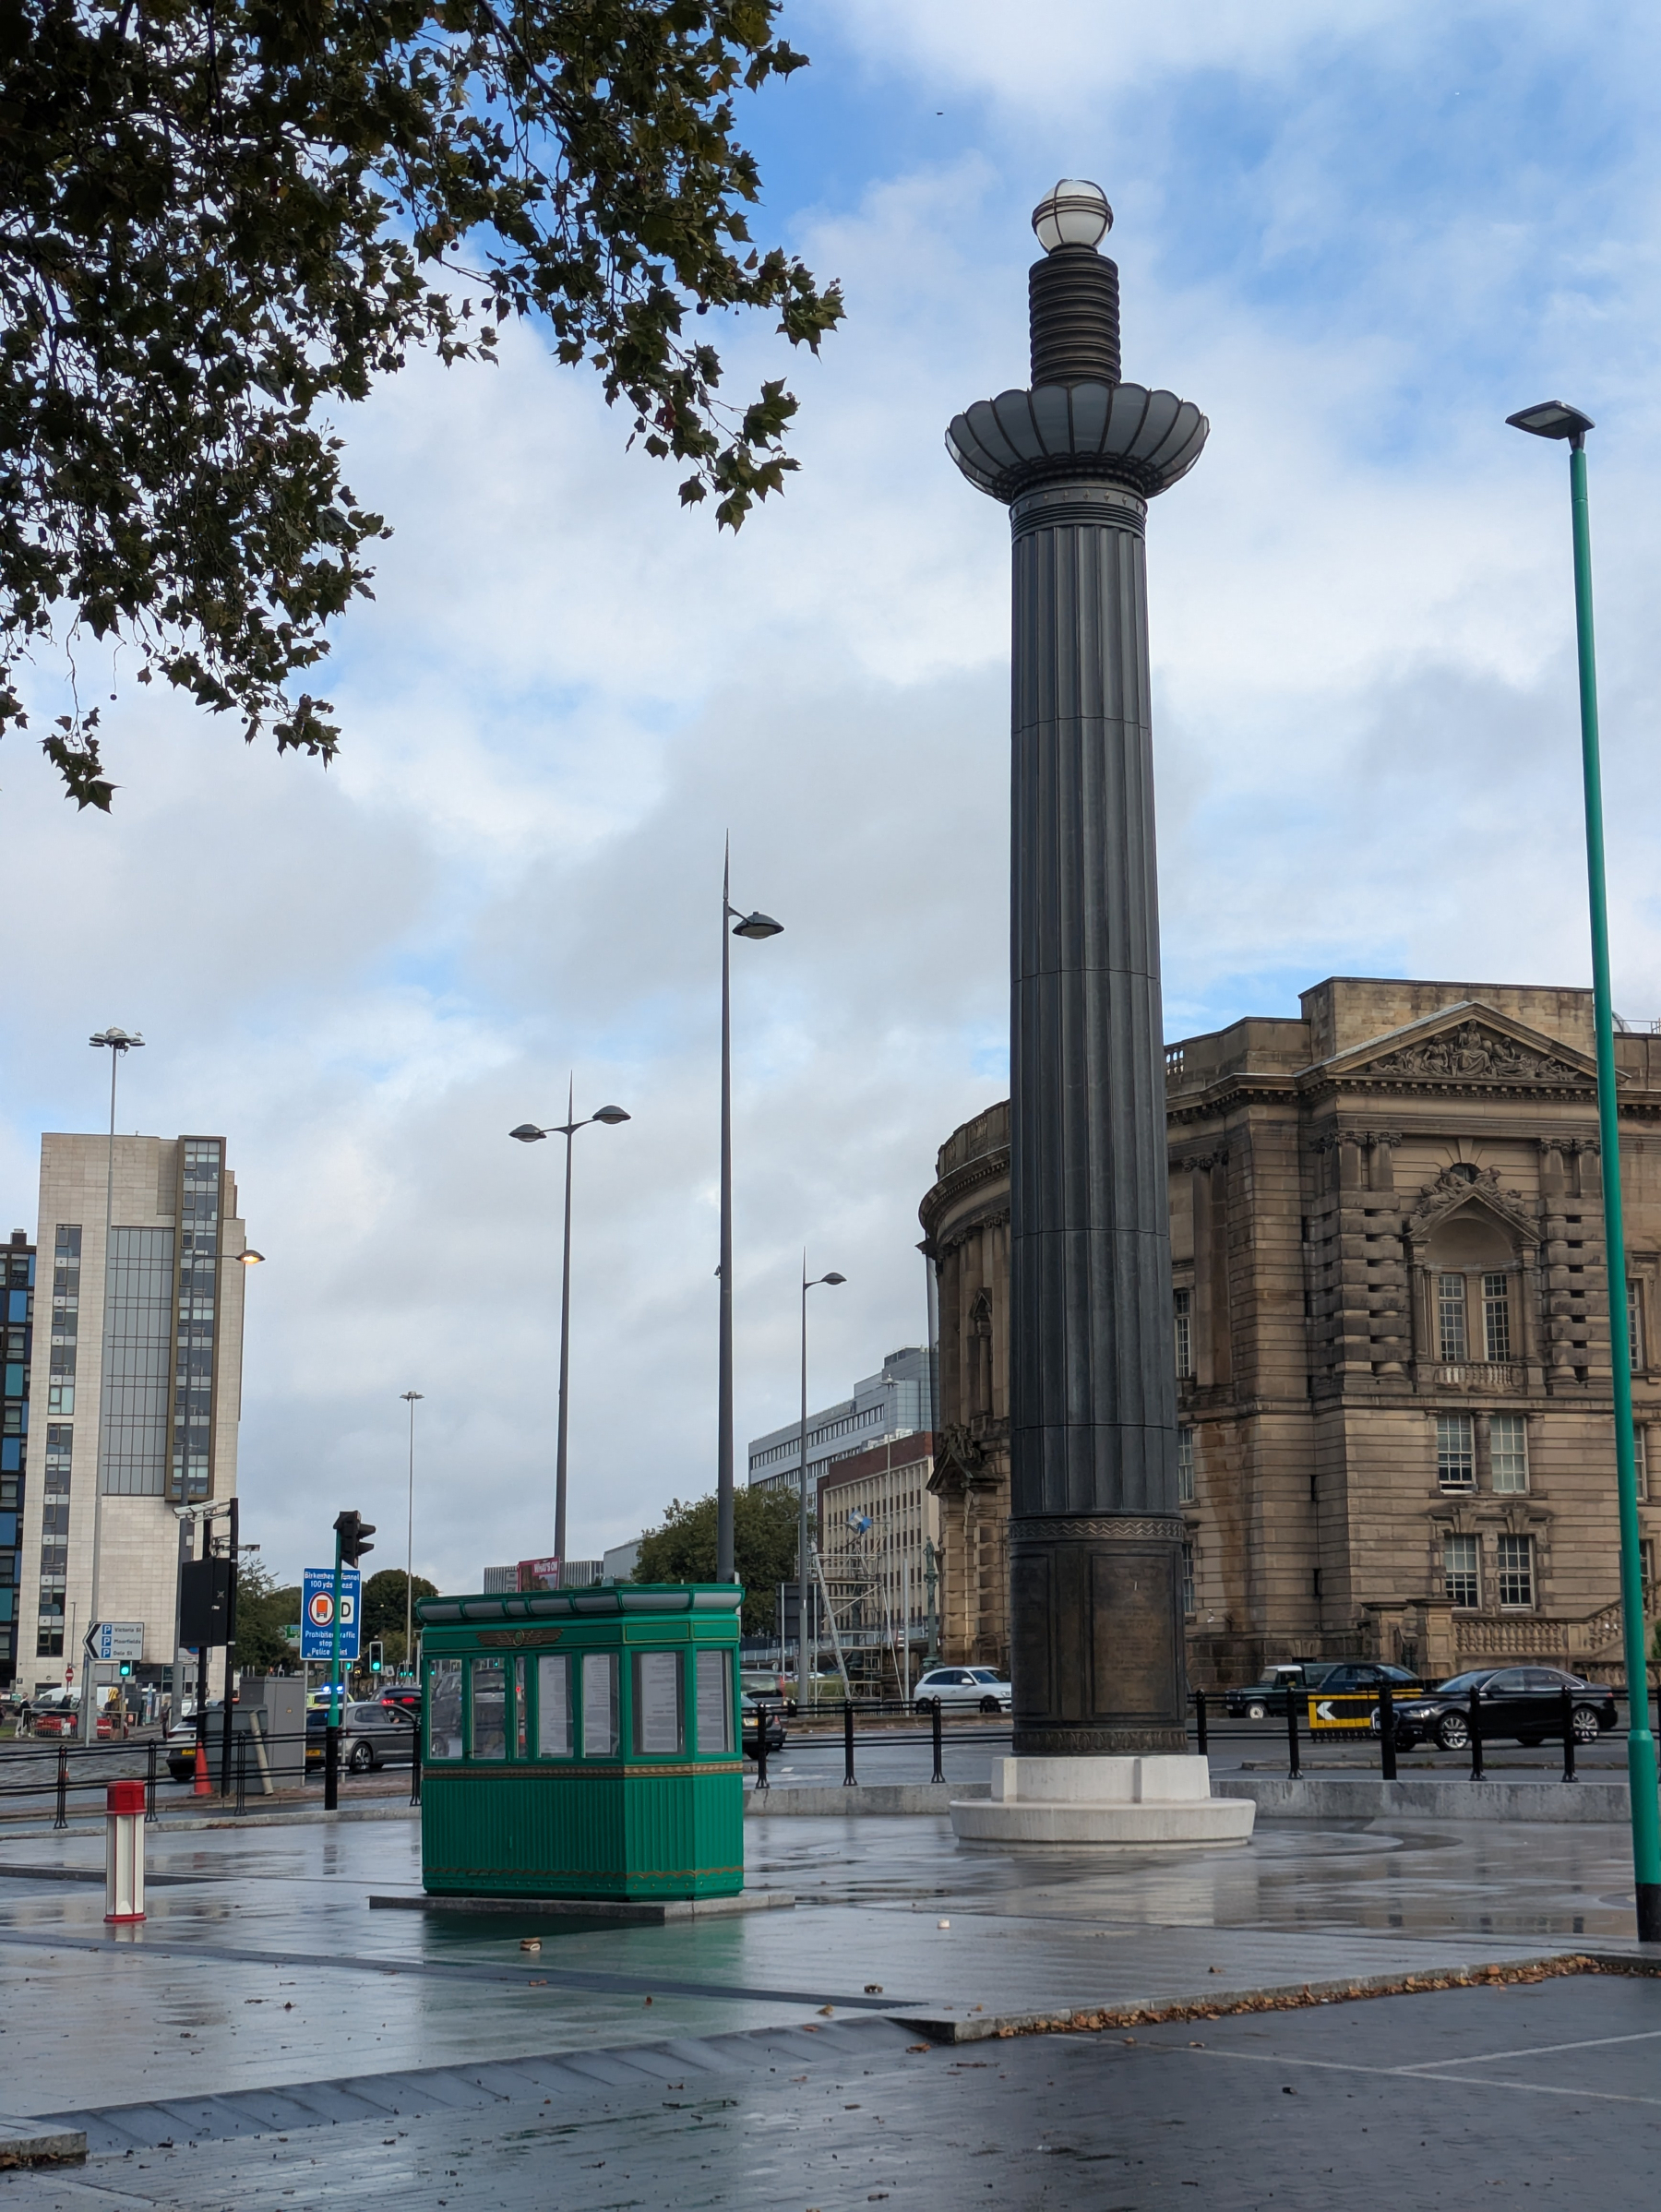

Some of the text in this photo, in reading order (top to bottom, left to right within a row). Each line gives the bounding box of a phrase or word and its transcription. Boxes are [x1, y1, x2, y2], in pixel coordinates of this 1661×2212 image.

[341, 1602, 351, 1617] D
[104, 1625, 111, 1633] P
[103, 1637, 110, 1645] P
[102, 1648, 109, 1657] P
